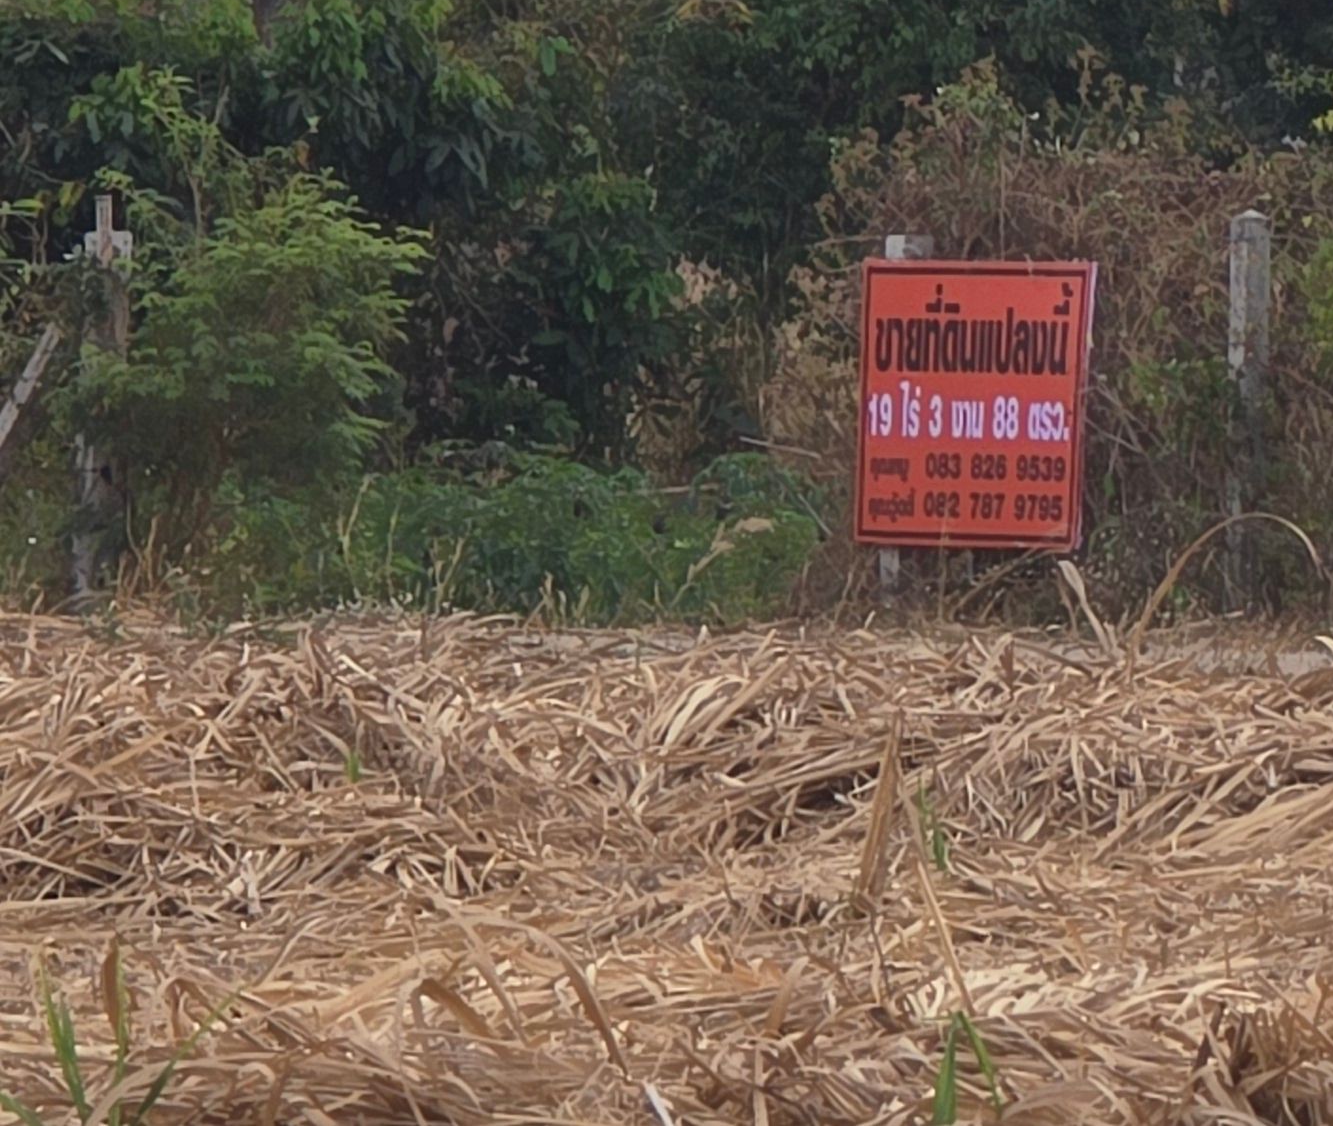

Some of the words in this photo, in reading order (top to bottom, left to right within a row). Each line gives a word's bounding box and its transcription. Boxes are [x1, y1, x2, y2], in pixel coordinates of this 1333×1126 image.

[875, 282, 1074, 375] ขายที่ดินแปลงนี้
[868, 393, 893, 437] 19
[899, 380, 921, 438] ไร่
[928, 394, 943, 438] 3
[950, 400, 985, 439] งาน
[992, 396, 1019, 440] 88
[924, 453, 962, 480] 083
[970, 454, 1007, 480] 826
[1015, 455, 1067, 482] 9539
[922, 491, 961, 519] 082
[969, 492, 1006, 519] 787
[1013, 494, 1063, 522] 9795
